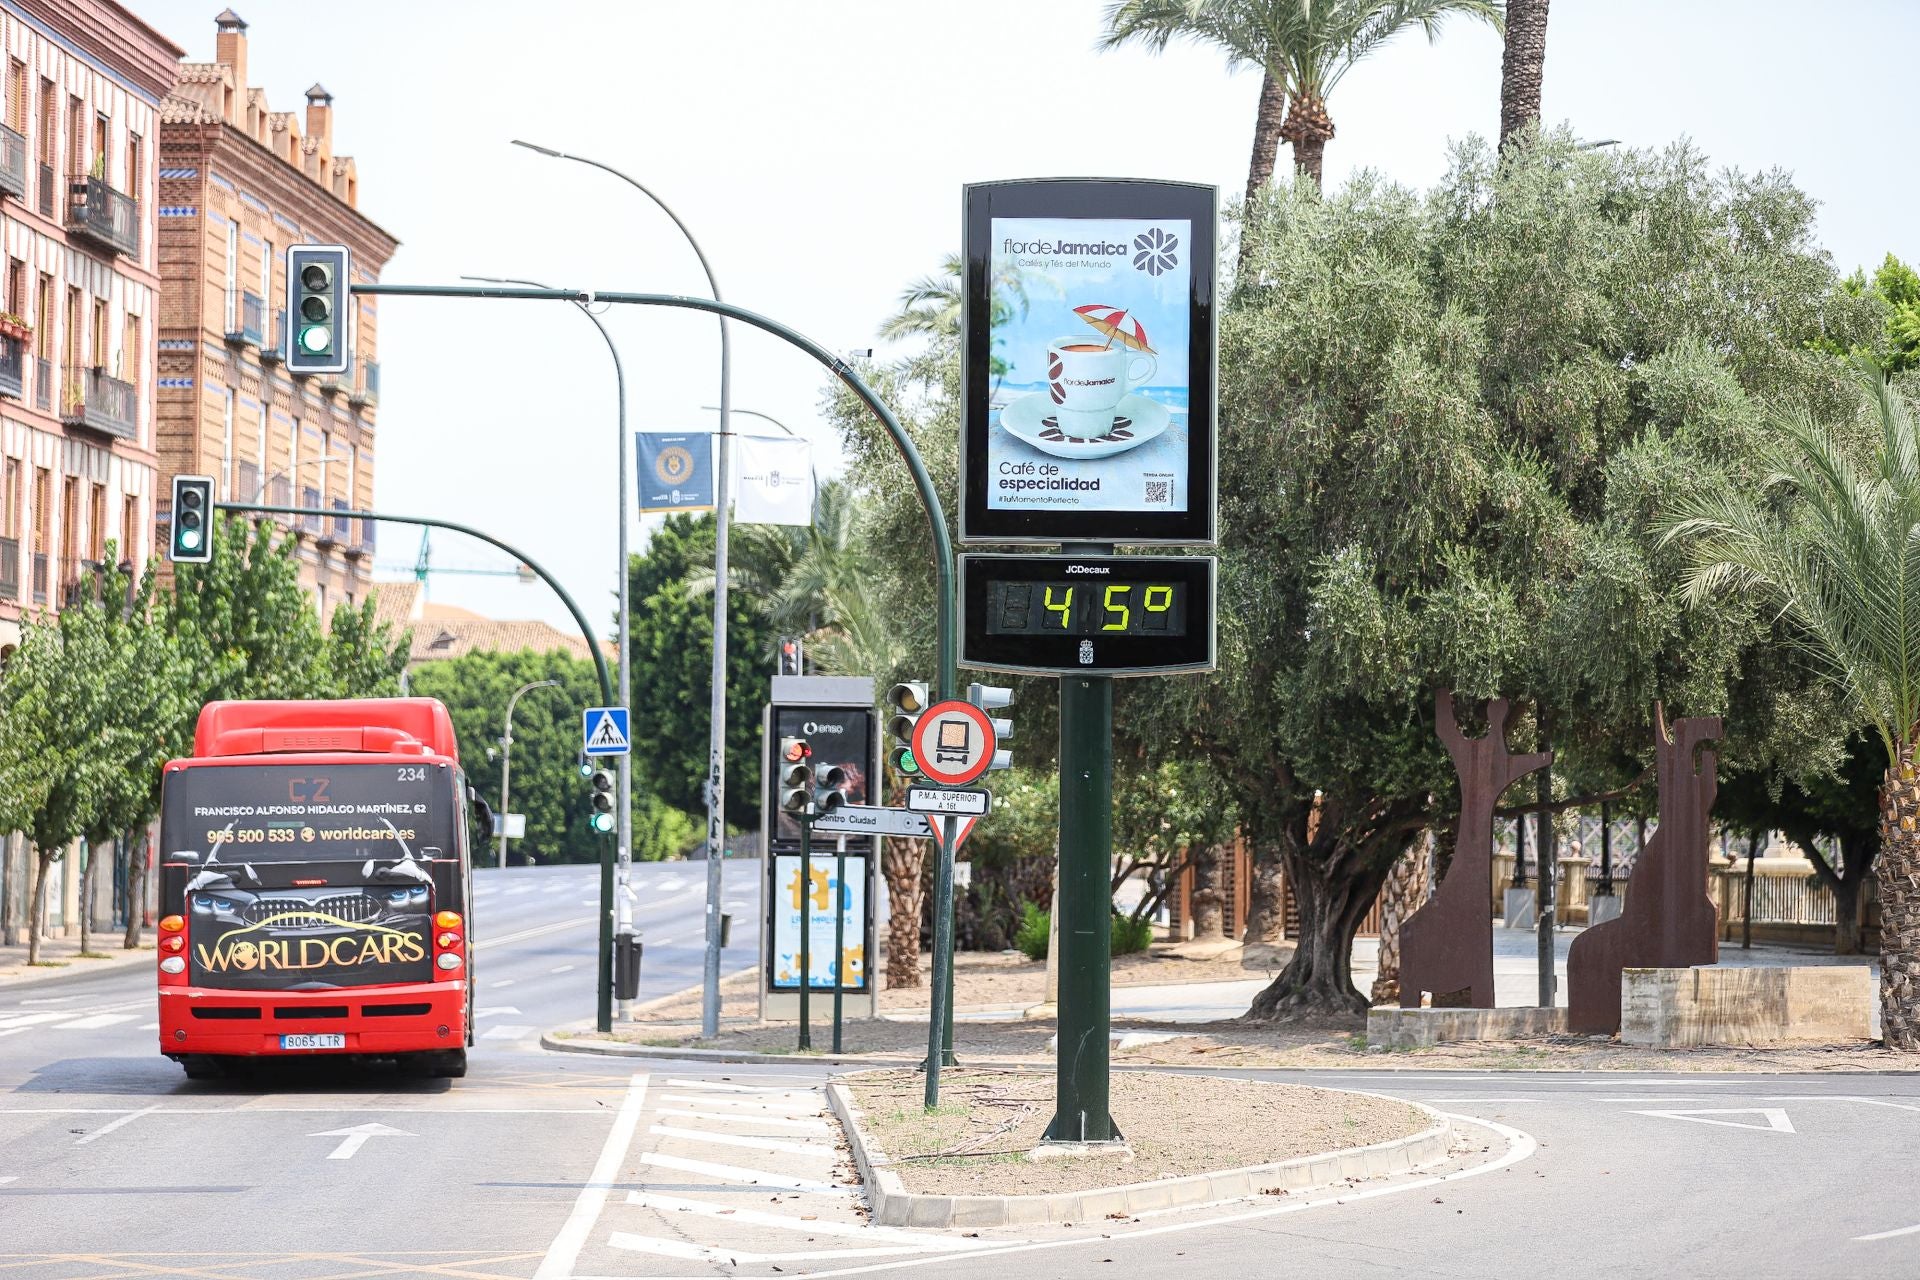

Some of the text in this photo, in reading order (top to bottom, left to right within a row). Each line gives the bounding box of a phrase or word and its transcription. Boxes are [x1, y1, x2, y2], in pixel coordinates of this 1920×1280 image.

[1043, 261, 1049, 269] y
[1051, 260, 1063, 268] Tés
[1066, 260, 1079, 268] del
[1081, 261, 1111, 269] Mundo
[1000, 462, 1059, 475] Café de
[999, 478, 1100, 492] especialidad
[999, 495, 1080, 505] #TuMomentoPerfecto
[1065, 565, 1110, 574] JCDecaux
[397, 768, 426, 781] 234
[918, 791, 977, 802] P.M.A. SUPERIOR
[194, 802, 427, 817] FRANCISCO ALFONSO HIDALGO MARTÍNEZ, 62
[849, 815, 877, 825] Ciudad
[237, 829, 264, 843] 500
[268, 828, 296, 842] 533
[197, 931, 425, 972] WORLDCARS
[288, 1035, 340, 1047] 8065 LTR
